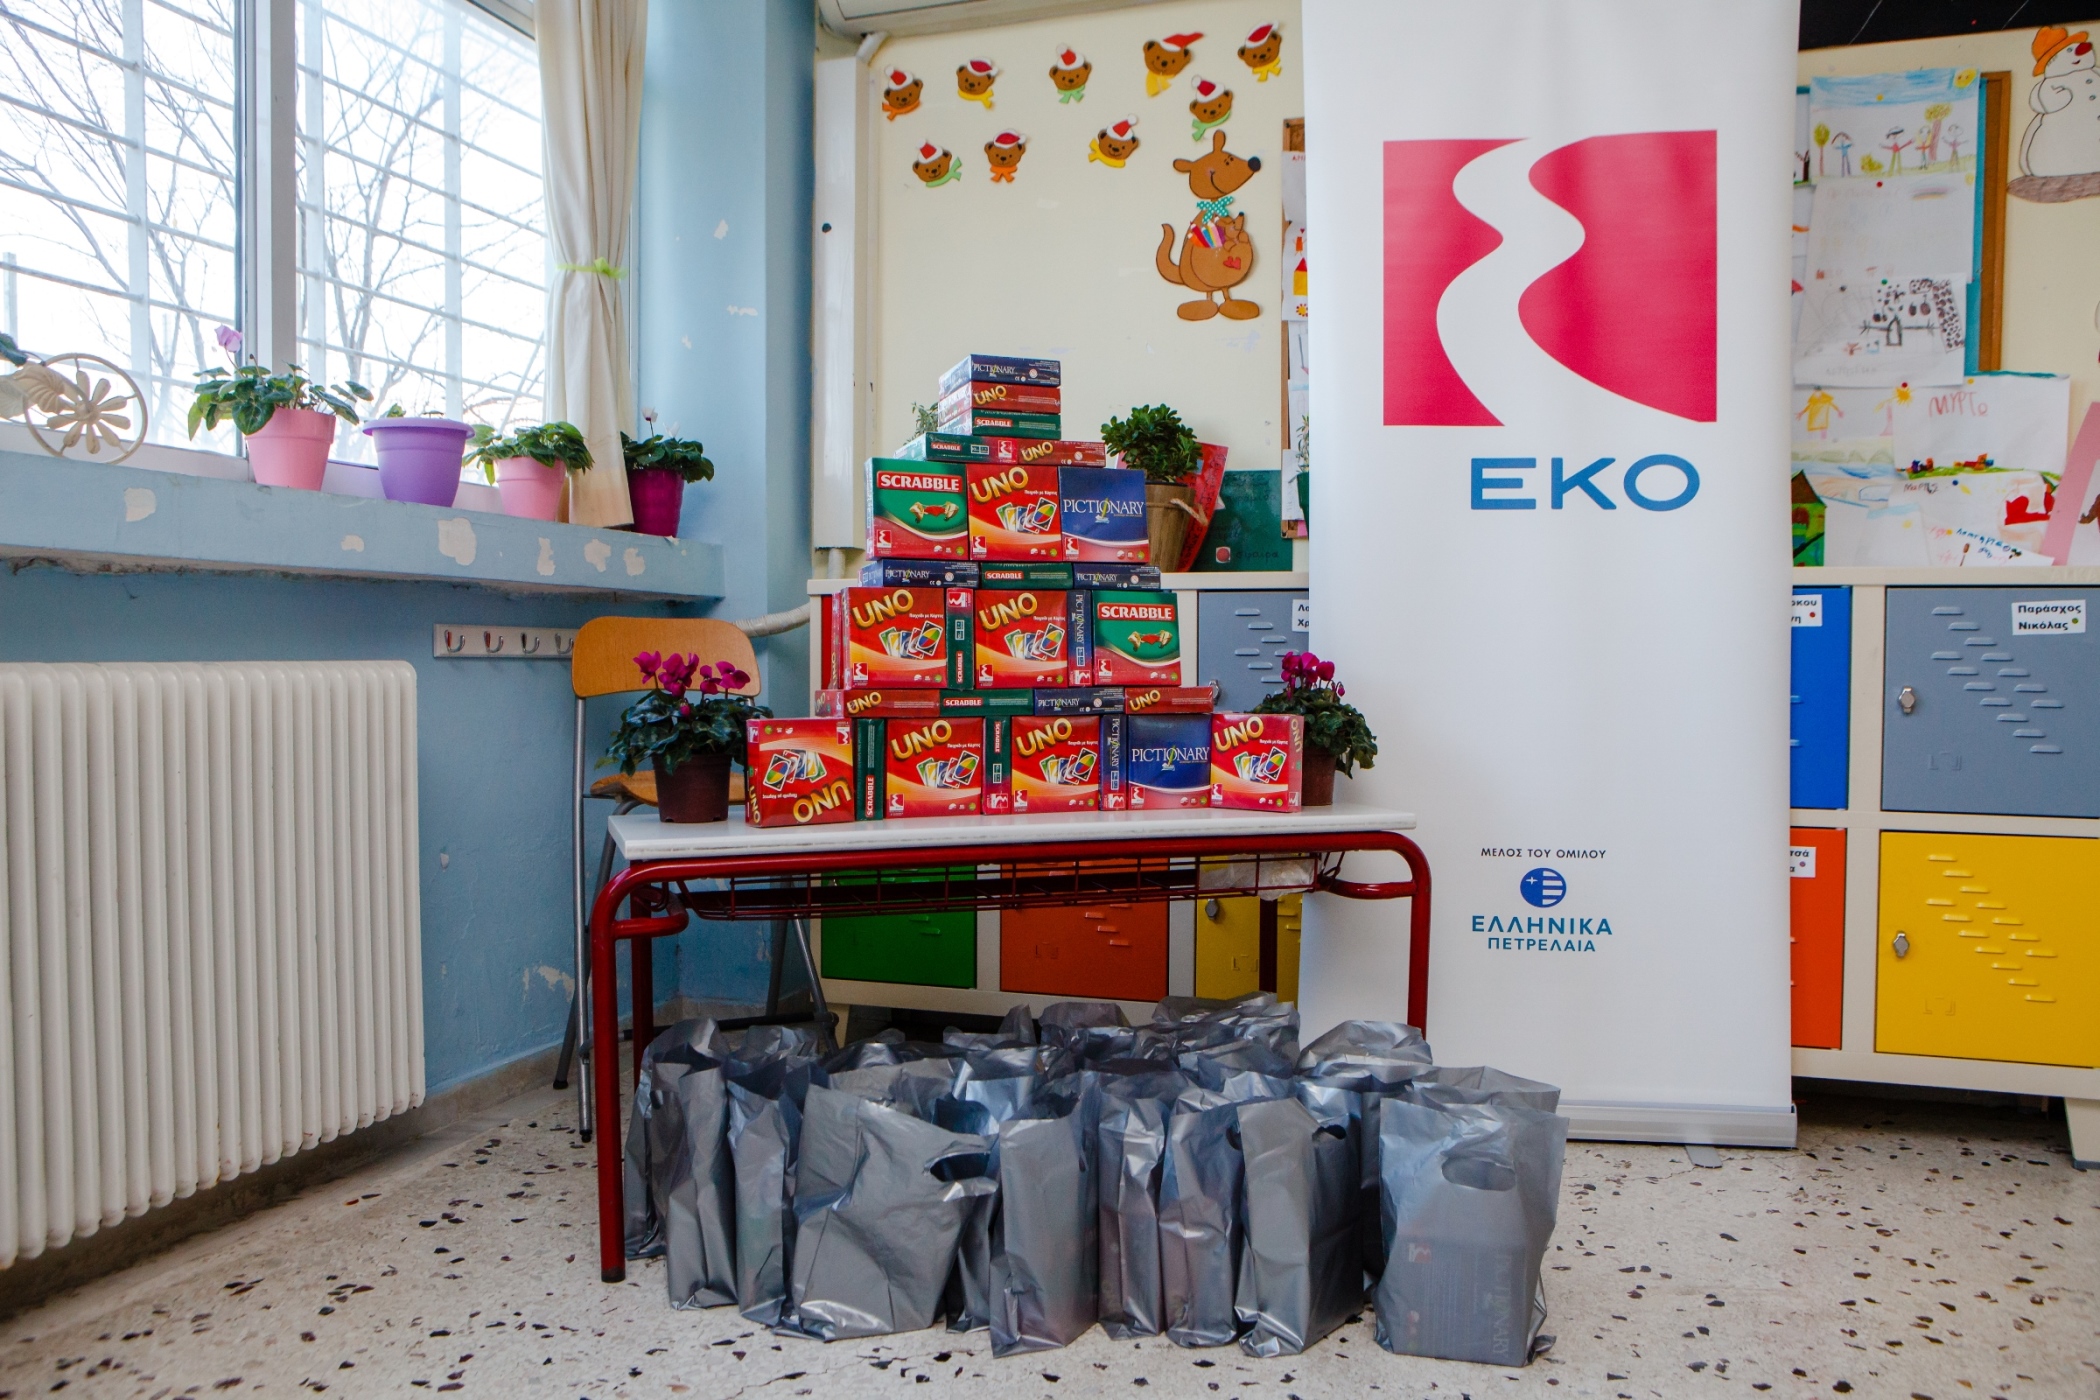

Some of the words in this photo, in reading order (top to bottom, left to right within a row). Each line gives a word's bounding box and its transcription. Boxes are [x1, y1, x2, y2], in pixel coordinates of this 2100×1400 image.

[973, 363, 1016, 374] PICTIONARY
[974, 385, 1006, 405] UNO
[976, 418, 1012, 428] SCRABBLE
[932, 443, 961, 451] SCRABBLE
[1022, 441, 1054, 462] UNO
[880, 474, 960, 491] SCRABBLE
[970, 467, 1028, 502] UNO
[1471, 454, 1700, 512] EKO
[1063, 499, 1144, 515] PICTIONARY
[885, 568, 930, 579] PICTIONARY
[986, 572, 1022, 580] SCRABBLE
[1077, 572, 1118, 582] PICTIONARY
[852, 589, 914, 628] UNO
[978, 592, 1038, 630] UNO
[1076, 594, 1084, 643] PICTIONARY
[1102, 606, 1172, 619] SCRABBLE
[2018, 604, 2082, 614] Παράσχος
[2018, 621, 2068, 630] Νικόλας
[846, 691, 882, 714] UNO
[1038, 698, 1080, 706] PICTIONARY
[1129, 690, 1160, 712] UNO
[890, 720, 952, 759] UNO
[1016, 718, 1072, 756] UNO
[1112, 718, 1120, 768] PICTIONARY
[1214, 716, 1264, 752] UNO
[1132, 746, 1210, 762] PICTIONARY
[750, 786, 760, 824] UNO
[793, 780, 852, 822] UNO
[866, 776, 874, 816] SCRABBLE
[1481, 848, 1522, 857] ΜΕΛΟΣ
[1528, 849, 1551, 858] ΤΟΥ
[1556, 850, 1606, 859] ΟΜΙΛΟΥ
[1472, 915, 1612, 935] ΕΛΛΗΝΙΚΑ
[1488, 937, 1596, 952] ΠΕΤΡΕΛΑΙΑ
